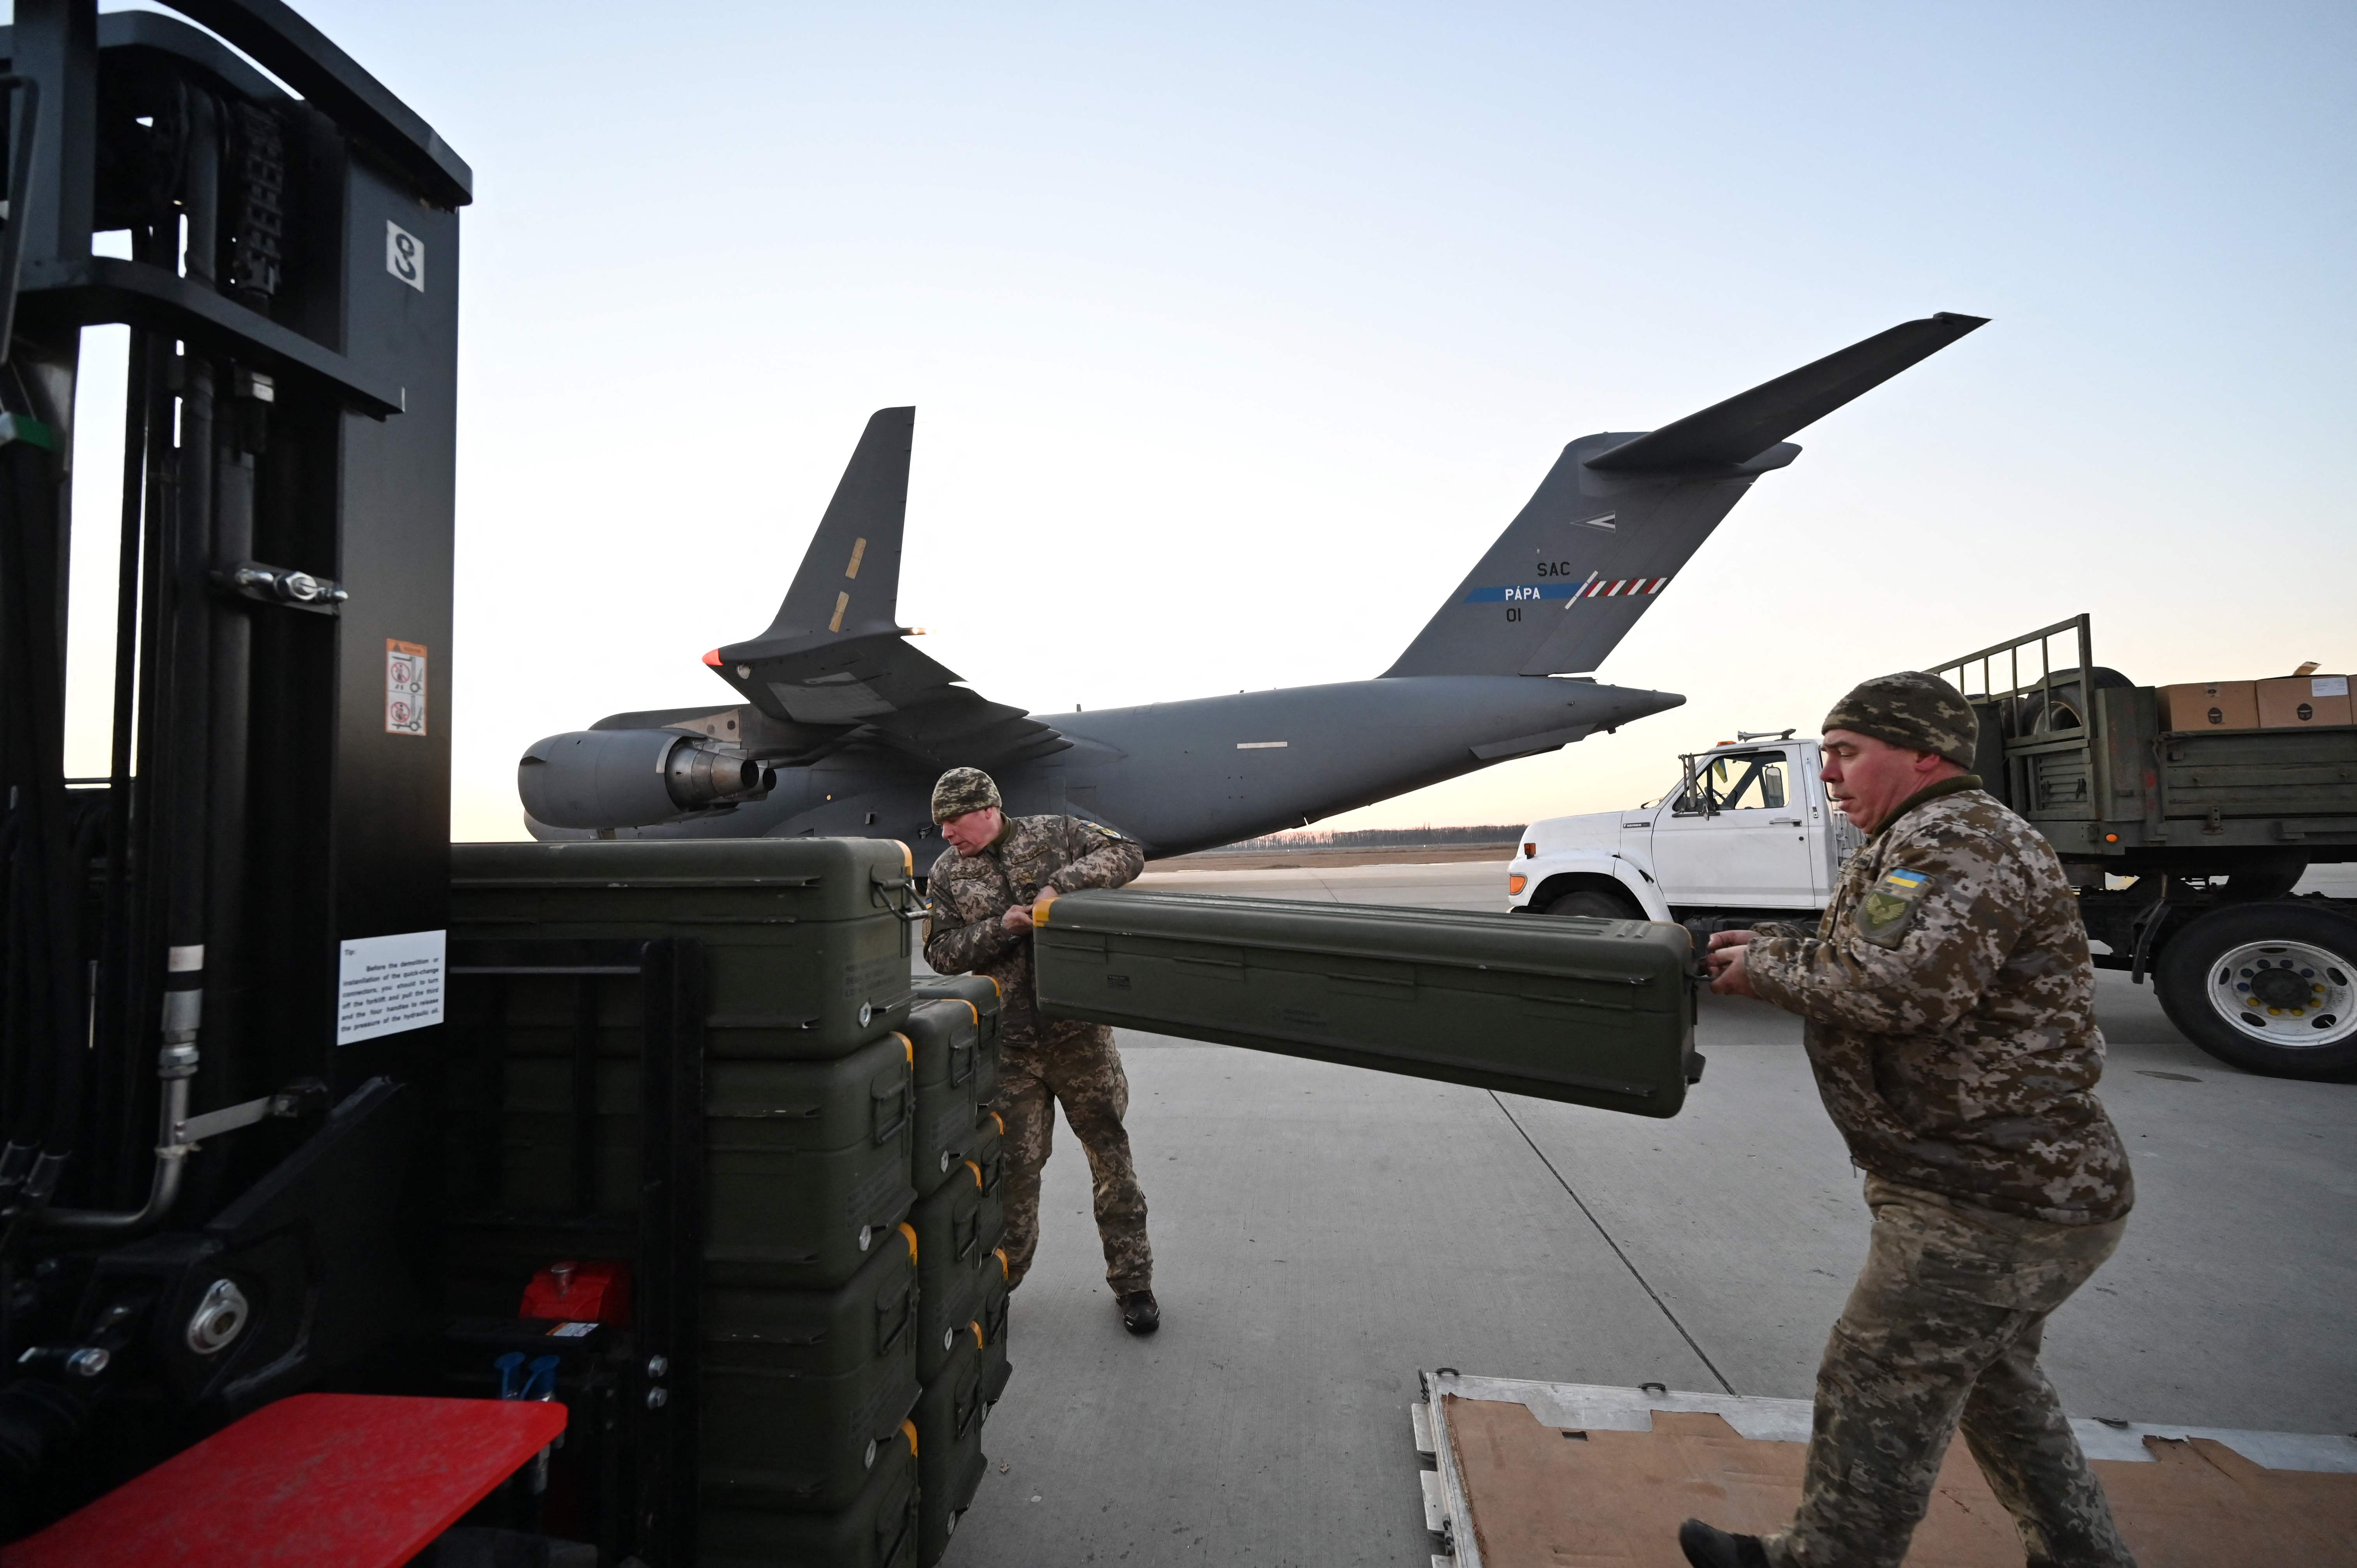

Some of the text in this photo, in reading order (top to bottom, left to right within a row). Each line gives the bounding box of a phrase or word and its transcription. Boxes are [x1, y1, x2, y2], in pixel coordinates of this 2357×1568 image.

[1537, 562, 1570, 577] SAC
[1505, 586, 1541, 601] PÁPA
[1506, 608, 1521, 622] 01
[400, 959, 429, 967] demolition
[403, 968, 439, 978] quick-change
[397, 981, 416, 989] should
[366, 996, 386, 1005] forklift
[386, 1003, 409, 1012] handles
[353, 1020, 380, 1030] pressure
[403, 1010, 428, 1020] hydraulic
